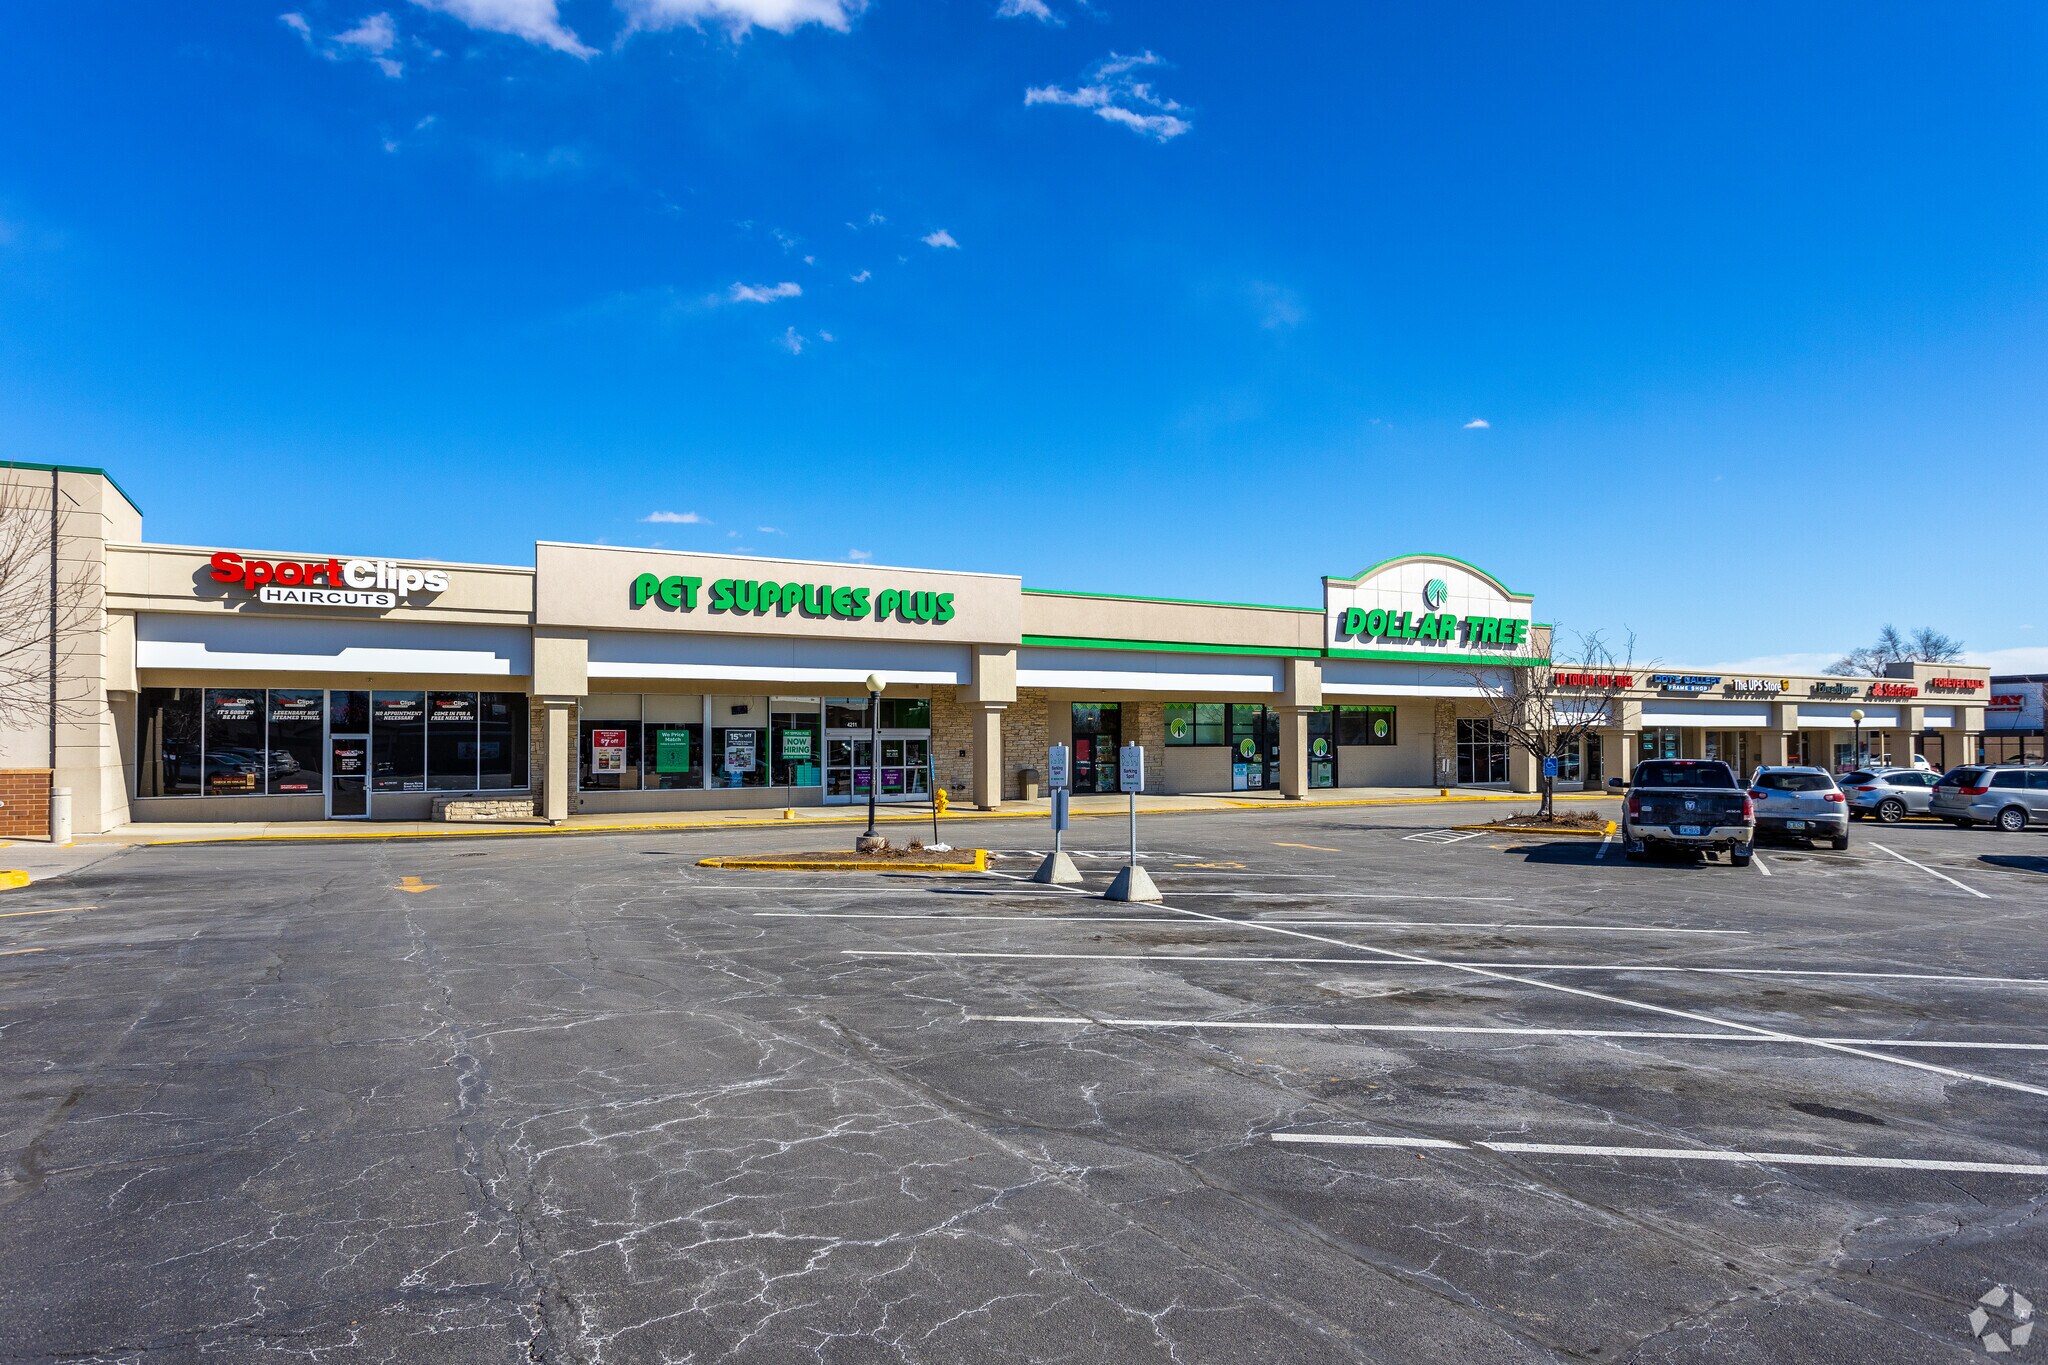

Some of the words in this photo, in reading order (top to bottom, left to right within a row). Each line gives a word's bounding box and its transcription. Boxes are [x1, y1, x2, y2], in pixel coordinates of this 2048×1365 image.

[266, 589, 389, 606] HAIRCUTS
[635, 572, 702, 608] PET
[714, 578, 871, 617] SUPPLIES
[879, 588, 955, 621] PLUS
[1344, 607, 1458, 641] DOLLAR
[1465, 615, 1529, 644] TREE
[1556, 673, 1566, 685] LA
[1683, 676, 1721, 684] GALLERY
[1934, 678, 1964, 688] FOREVER
[1966, 679, 1985, 689] NAILS
[1735, 680, 1747, 690] The
[1748, 680, 1763, 691] UPS
[1763, 680, 1781, 691] Store
[600, 738, 609, 747] $7
